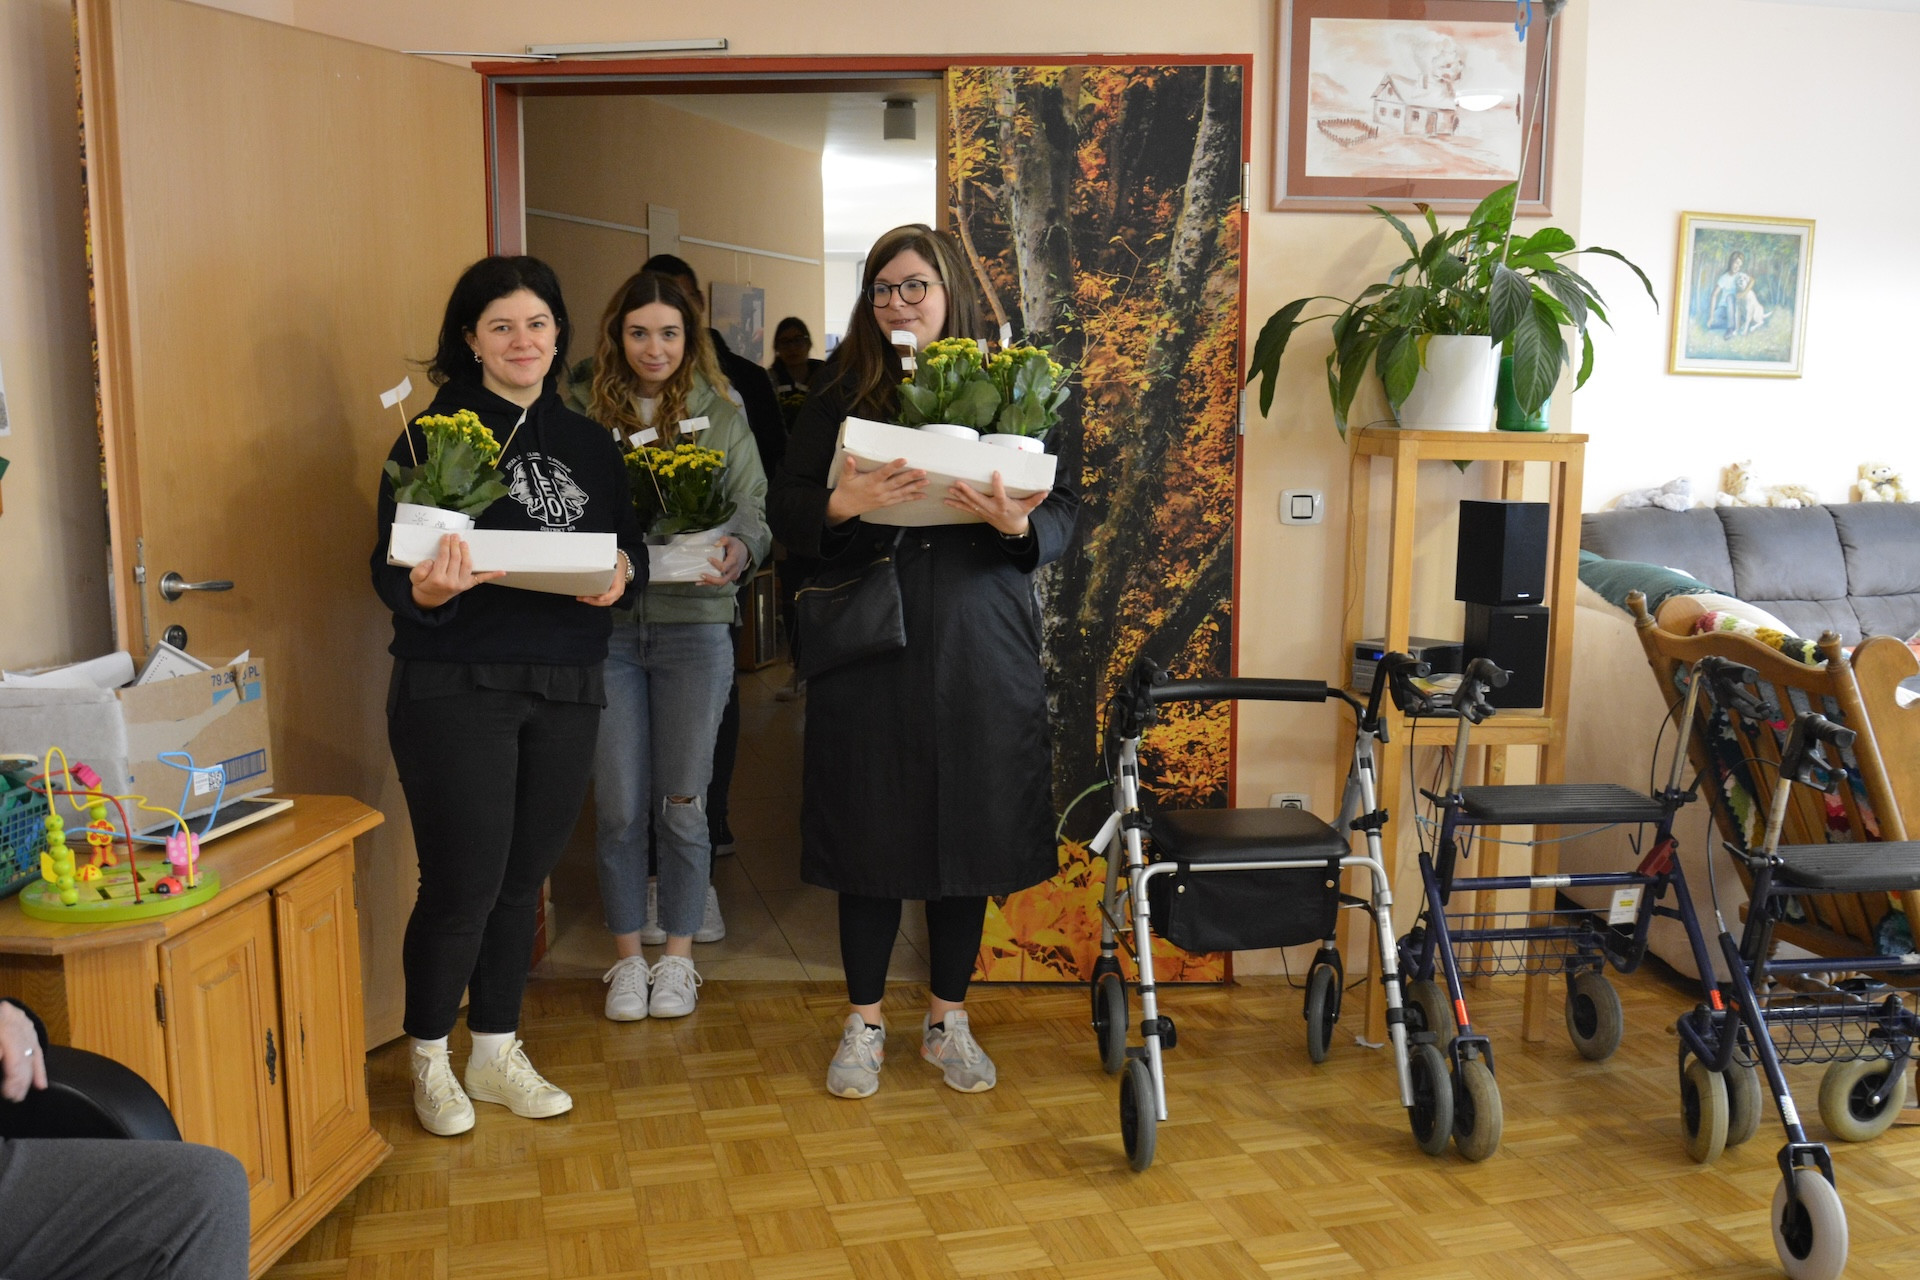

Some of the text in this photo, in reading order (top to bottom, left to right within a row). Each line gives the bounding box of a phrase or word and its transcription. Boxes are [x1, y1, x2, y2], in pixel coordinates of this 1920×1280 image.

[531, 462, 563, 517] LEO
[210, 673, 222, 687] 79
[248, 665, 260, 678] PL
